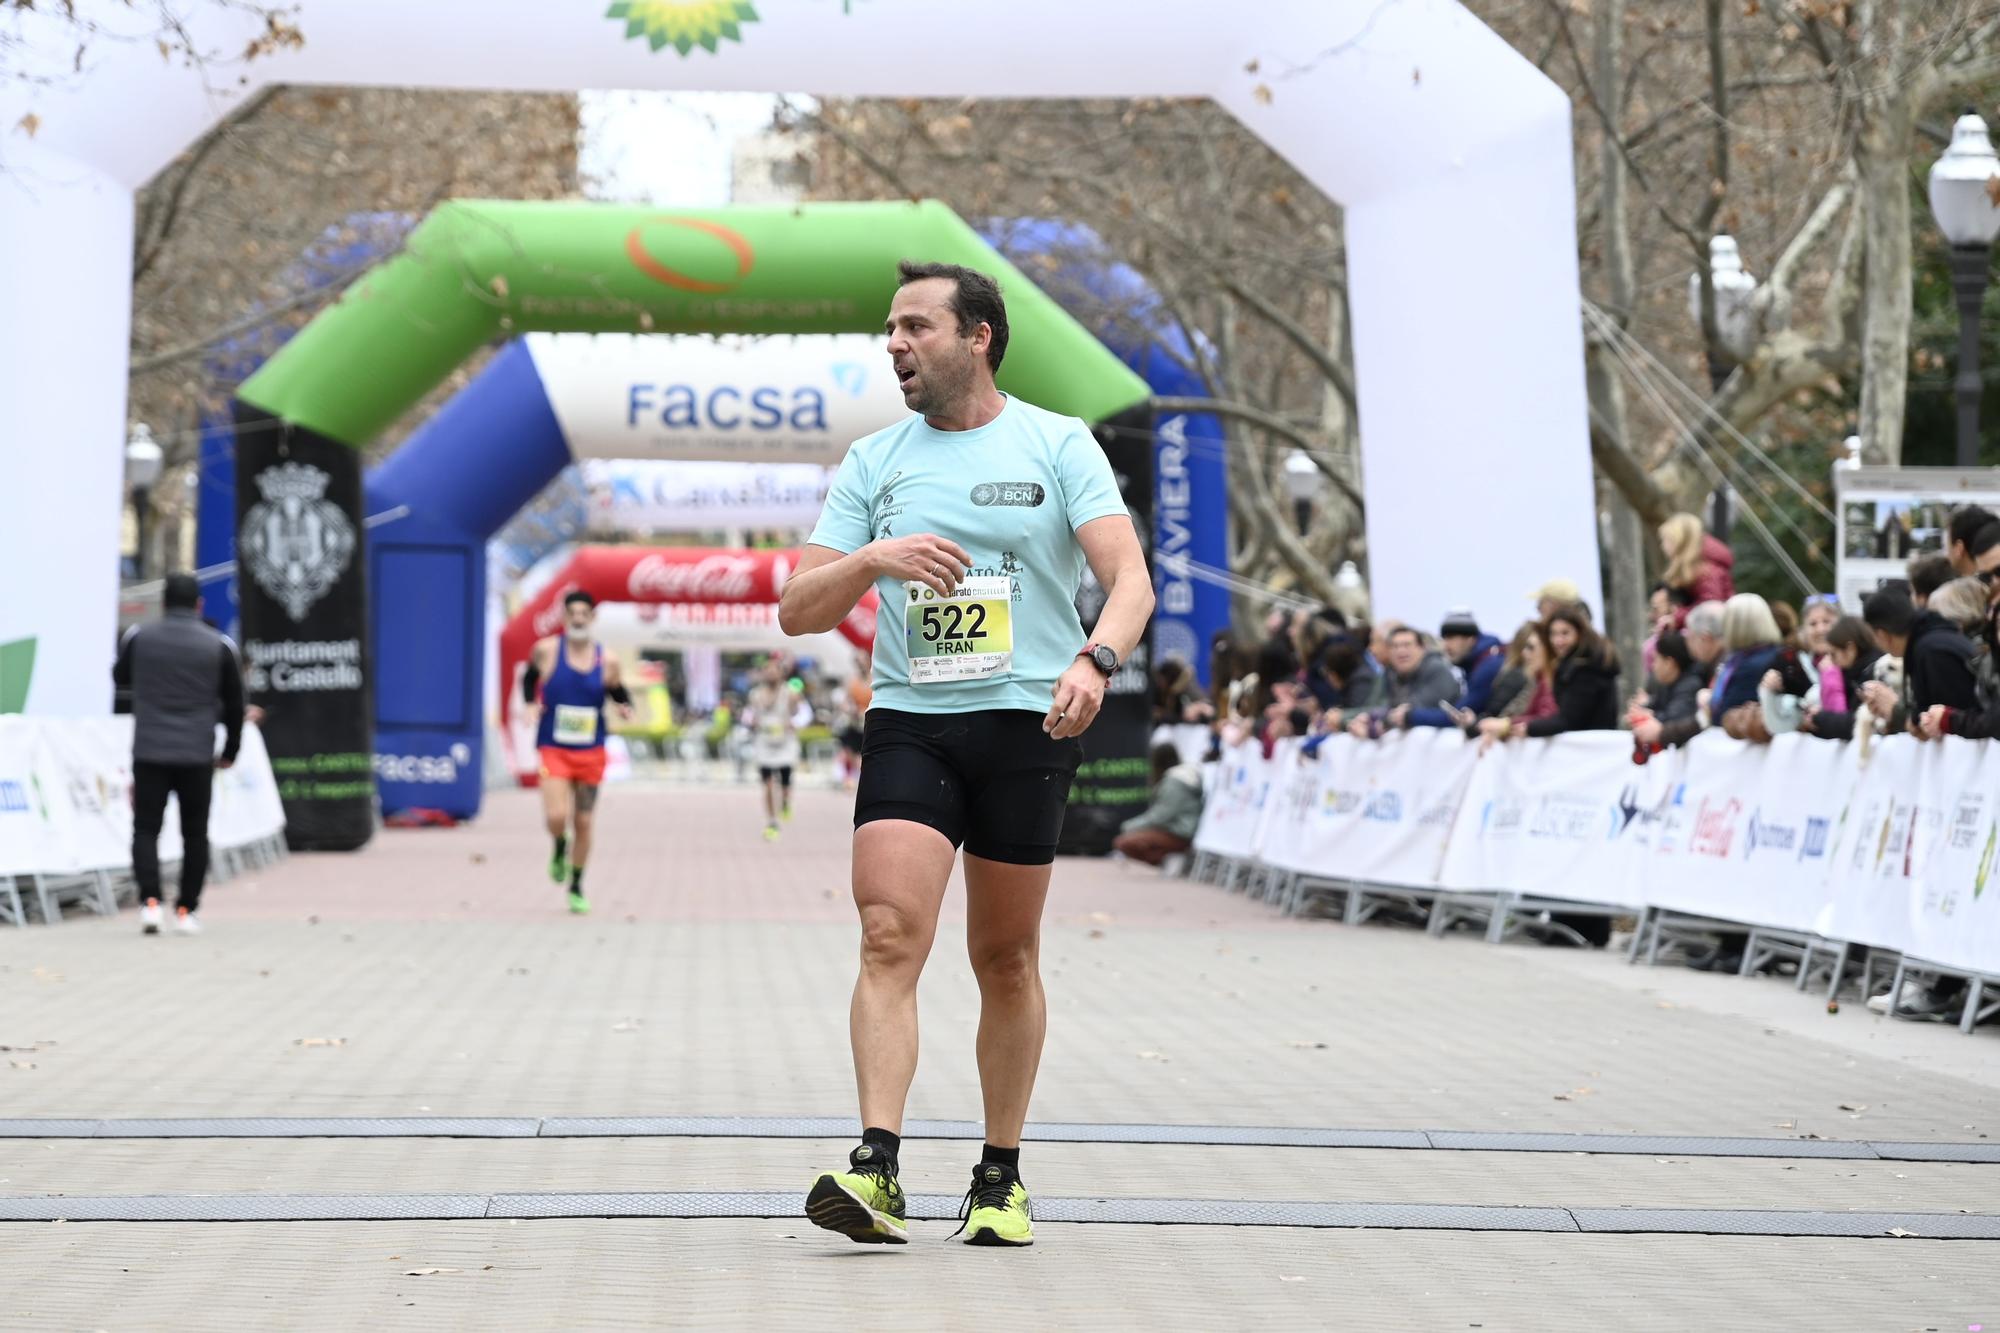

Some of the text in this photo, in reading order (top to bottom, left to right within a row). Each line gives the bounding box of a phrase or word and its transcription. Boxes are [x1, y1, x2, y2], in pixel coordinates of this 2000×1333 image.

[1004, 490, 1032, 501] BCN
[1159, 415, 1194, 614] BAVIERA
[922, 603, 988, 641] 522
[936, 640, 974, 655] FRAN
